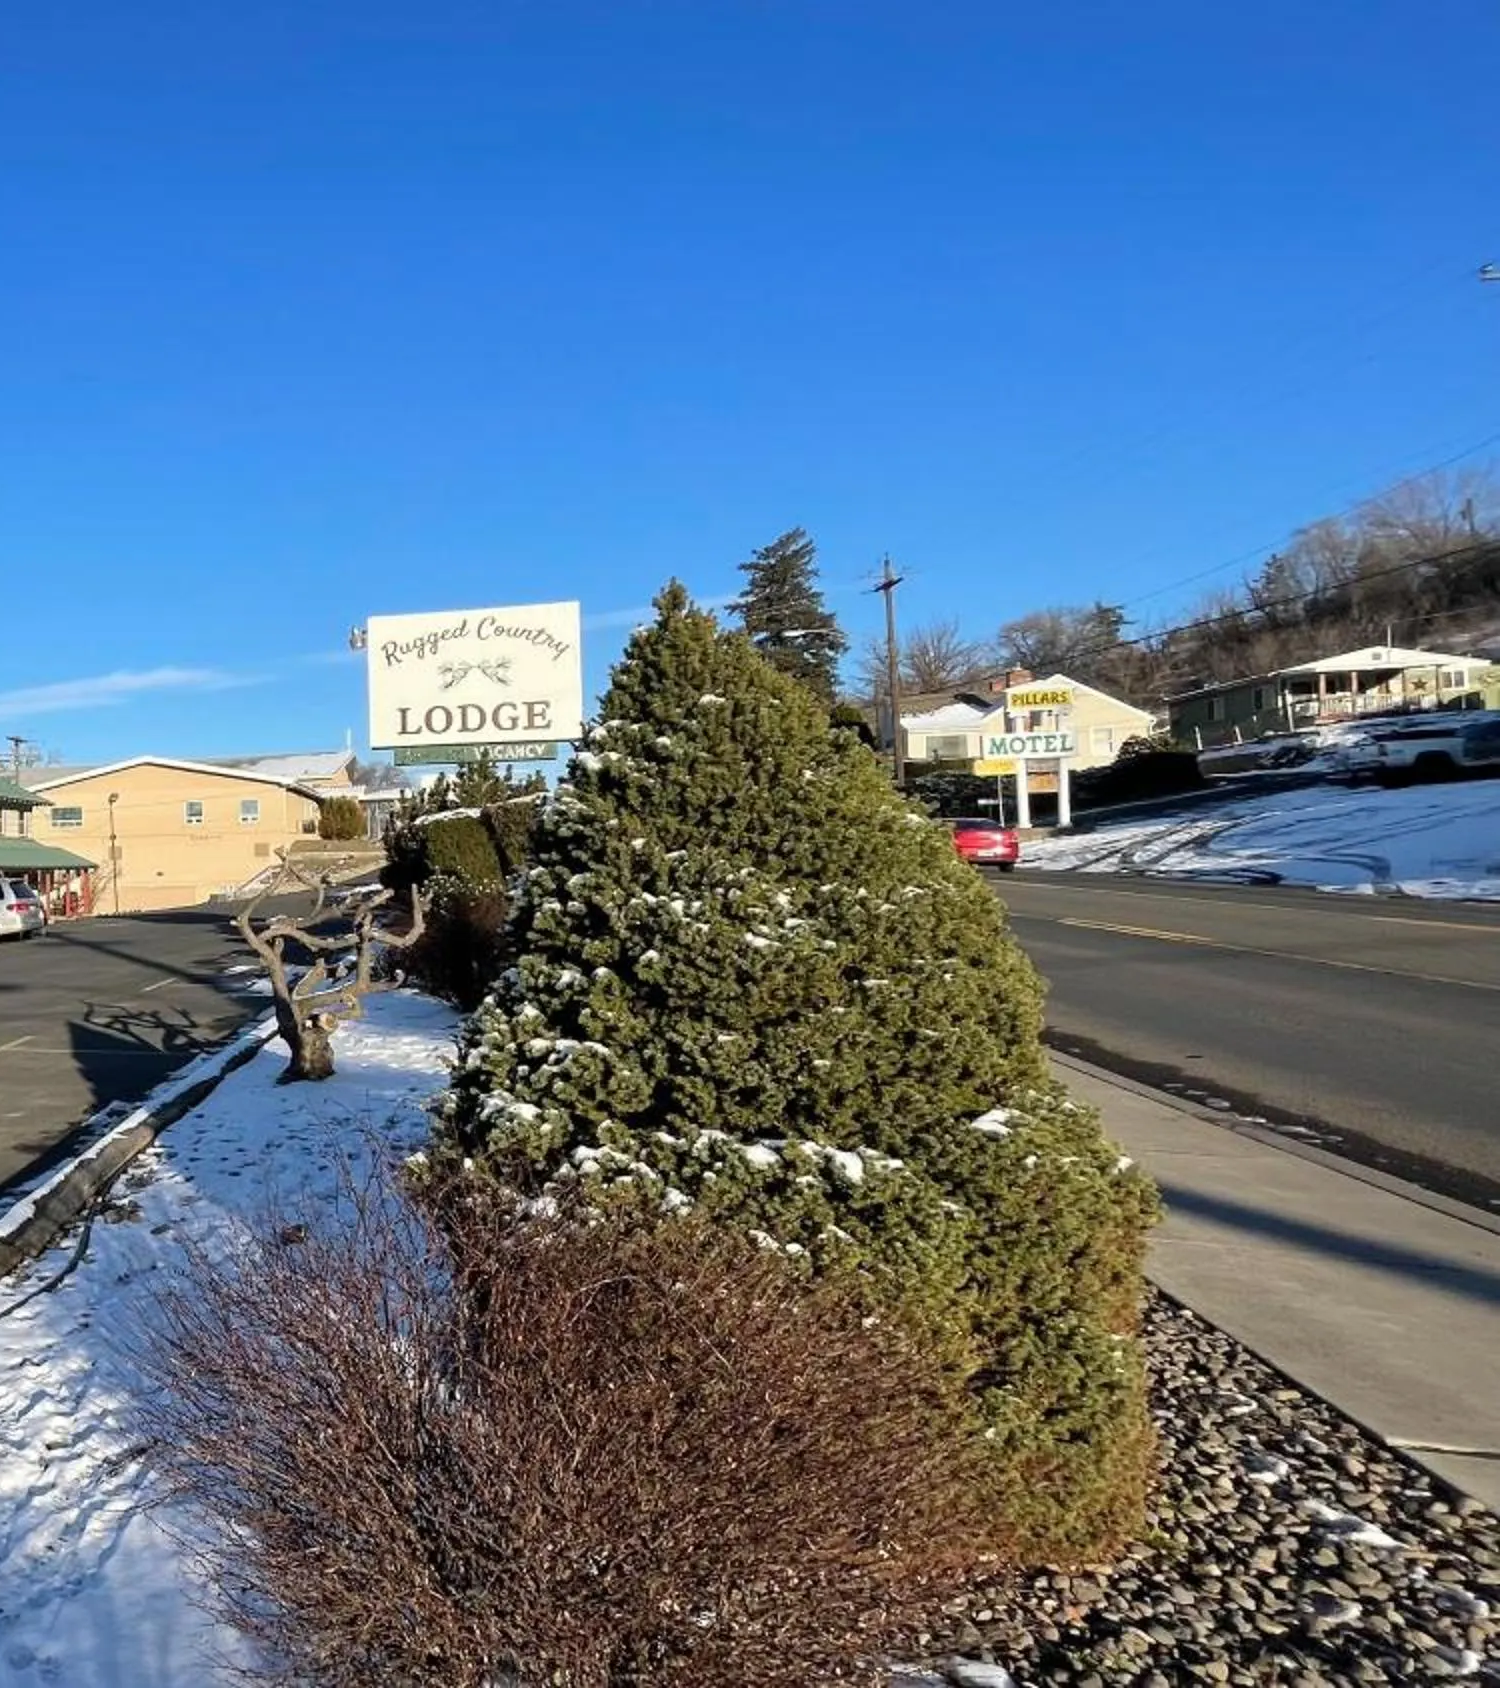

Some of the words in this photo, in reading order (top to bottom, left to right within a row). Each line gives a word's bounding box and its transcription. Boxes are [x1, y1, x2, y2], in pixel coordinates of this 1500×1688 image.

[381, 618, 469, 666] Rugged
[477, 615, 570, 661] Country
[1011, 691, 1068, 706] PILLARS
[397, 701, 552, 735] LODGE
[988, 734, 1073, 755] MOTEL
